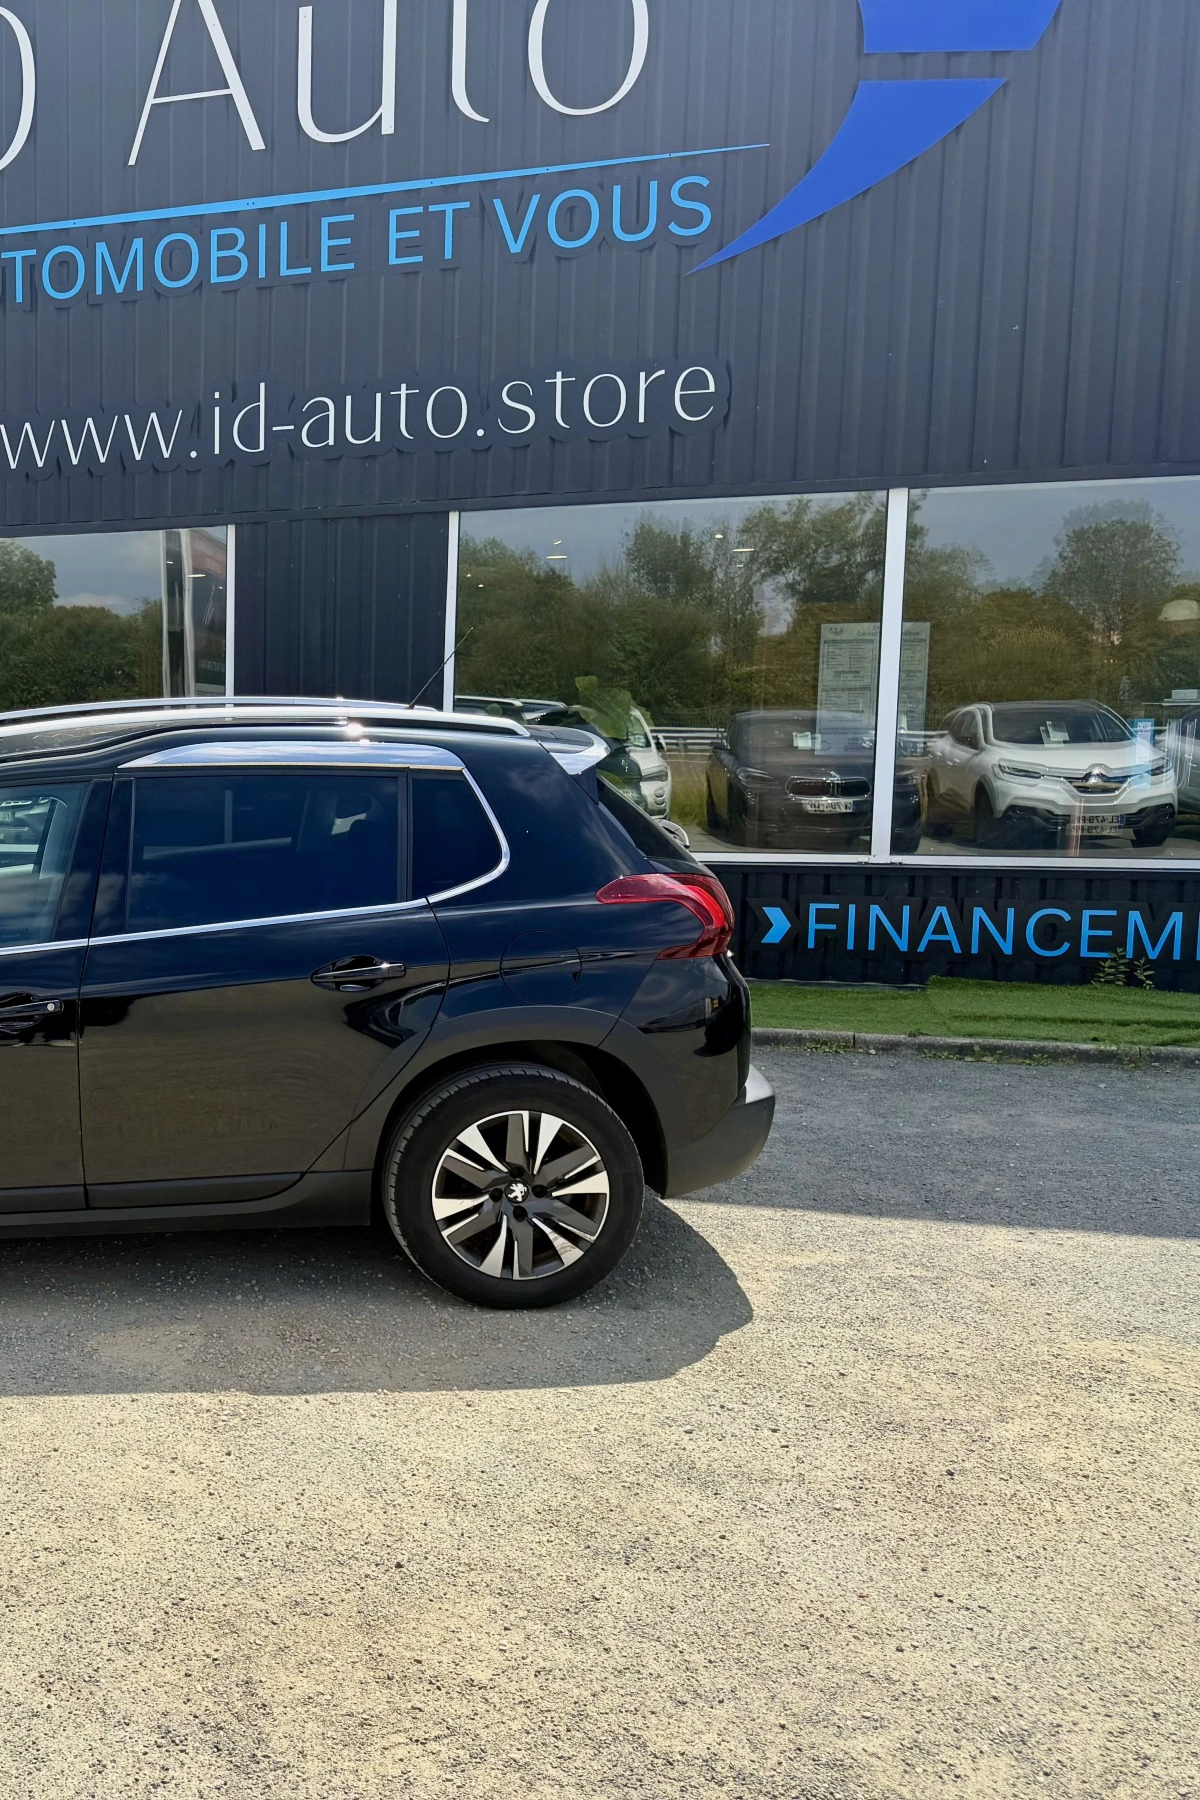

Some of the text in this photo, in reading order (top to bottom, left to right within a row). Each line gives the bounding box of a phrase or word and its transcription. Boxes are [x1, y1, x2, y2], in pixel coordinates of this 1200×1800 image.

[127, 0, 649, 167] Auto
[388, 200, 472, 267] ET
[492, 174, 713, 254] VOUS
[0, 366, 715, 469] www.id-auto.store
[807, 902, 1200, 961] FINANCEM
